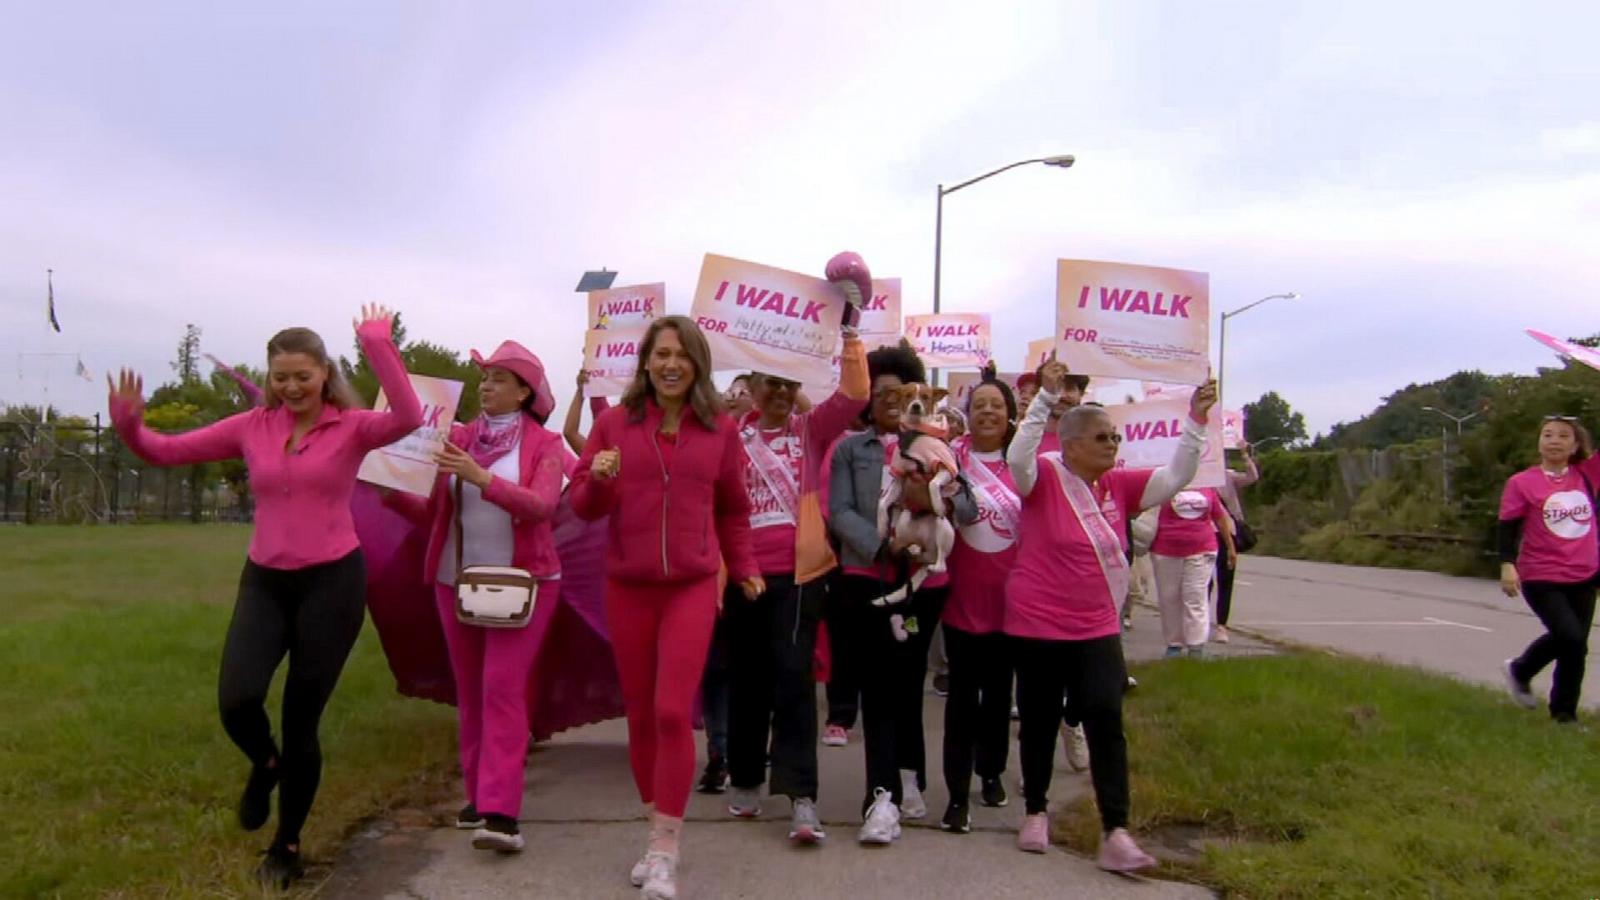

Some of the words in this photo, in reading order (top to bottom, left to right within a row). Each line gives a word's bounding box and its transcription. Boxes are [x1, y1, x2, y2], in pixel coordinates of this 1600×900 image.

[607, 297, 655, 316] WALK
[714, 281, 729, 301] I
[736, 284, 827, 324] WALK
[1078, 286, 1090, 308] I
[1100, 287, 1192, 318] WALK
[696, 316, 728, 333] FOR
[915, 326, 922, 338] I
[927, 324, 980, 337] WALK
[1064, 328, 1098, 342] FOR
[595, 344, 602, 358] I
[1125, 419, 1183, 442] WAL
